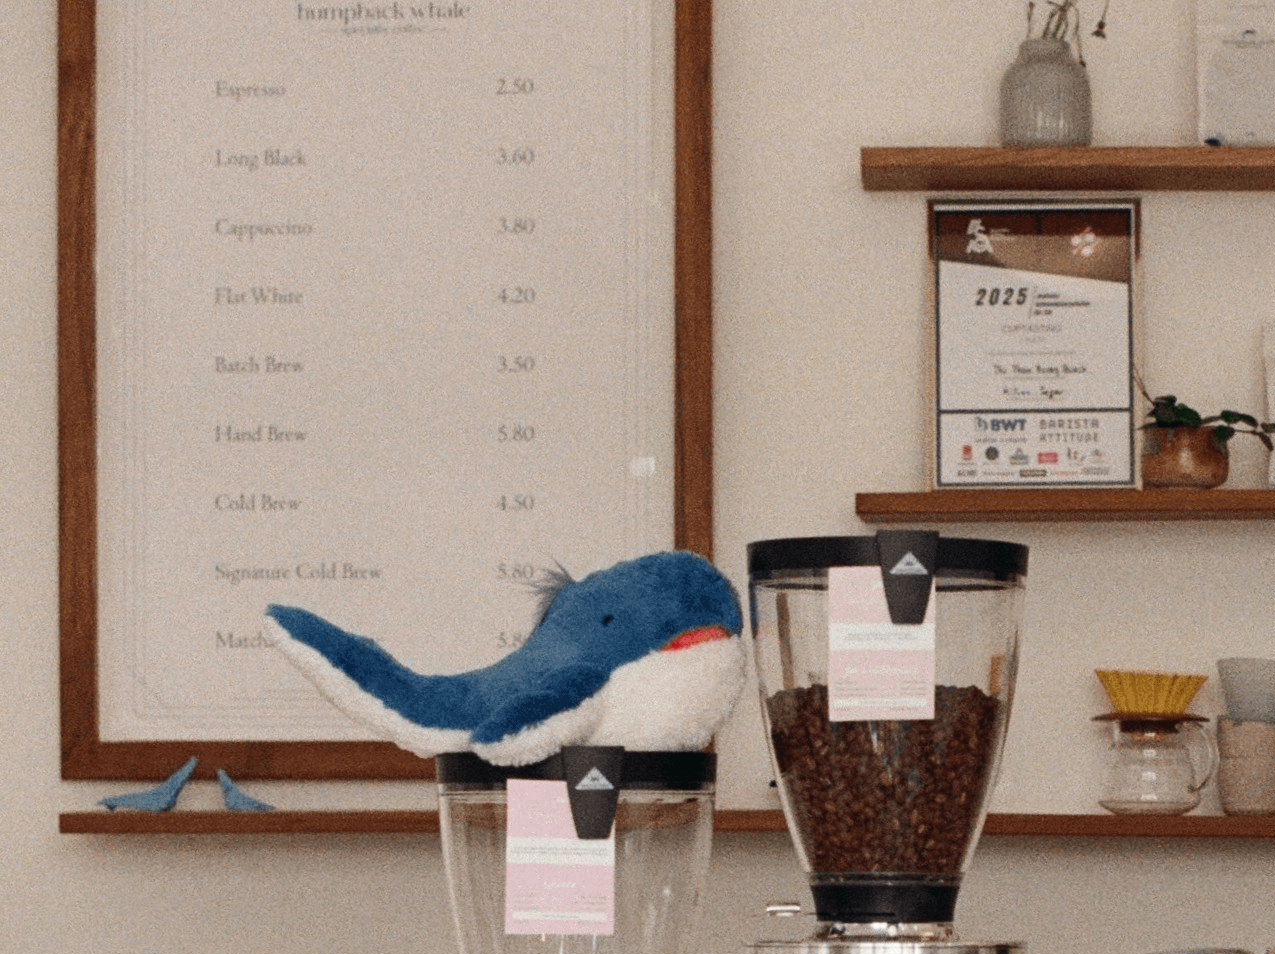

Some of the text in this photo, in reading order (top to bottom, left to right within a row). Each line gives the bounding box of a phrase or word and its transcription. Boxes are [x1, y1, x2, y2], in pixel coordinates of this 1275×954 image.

[297, 1, 471, 24] humpback whale
[215, 79, 286, 102] Espresso
[495, 78, 536, 96] 2.50
[215, 149, 306, 172] Long Black
[496, 147, 536, 165] 3.60
[215, 218, 313, 242] Cappuccino
[497, 217, 536, 234] 3.80
[214, 286, 303, 305] Flat White
[497, 286, 537, 305] 4.20
[975, 287, 1027, 306] 2025
[215, 355, 303, 374] Batch Brew
[497, 356, 536, 374] 3.50
[215, 424, 306, 443] Hand Brew
[497, 423, 536, 443] 5.80
[990, 418, 1028, 431] BWT
[214, 492, 301, 512] Cold Brew
[496, 494, 536, 512] 4.50
[215, 562, 382, 586] Signature Cold Brew
[497, 562, 535, 580] 5.80
